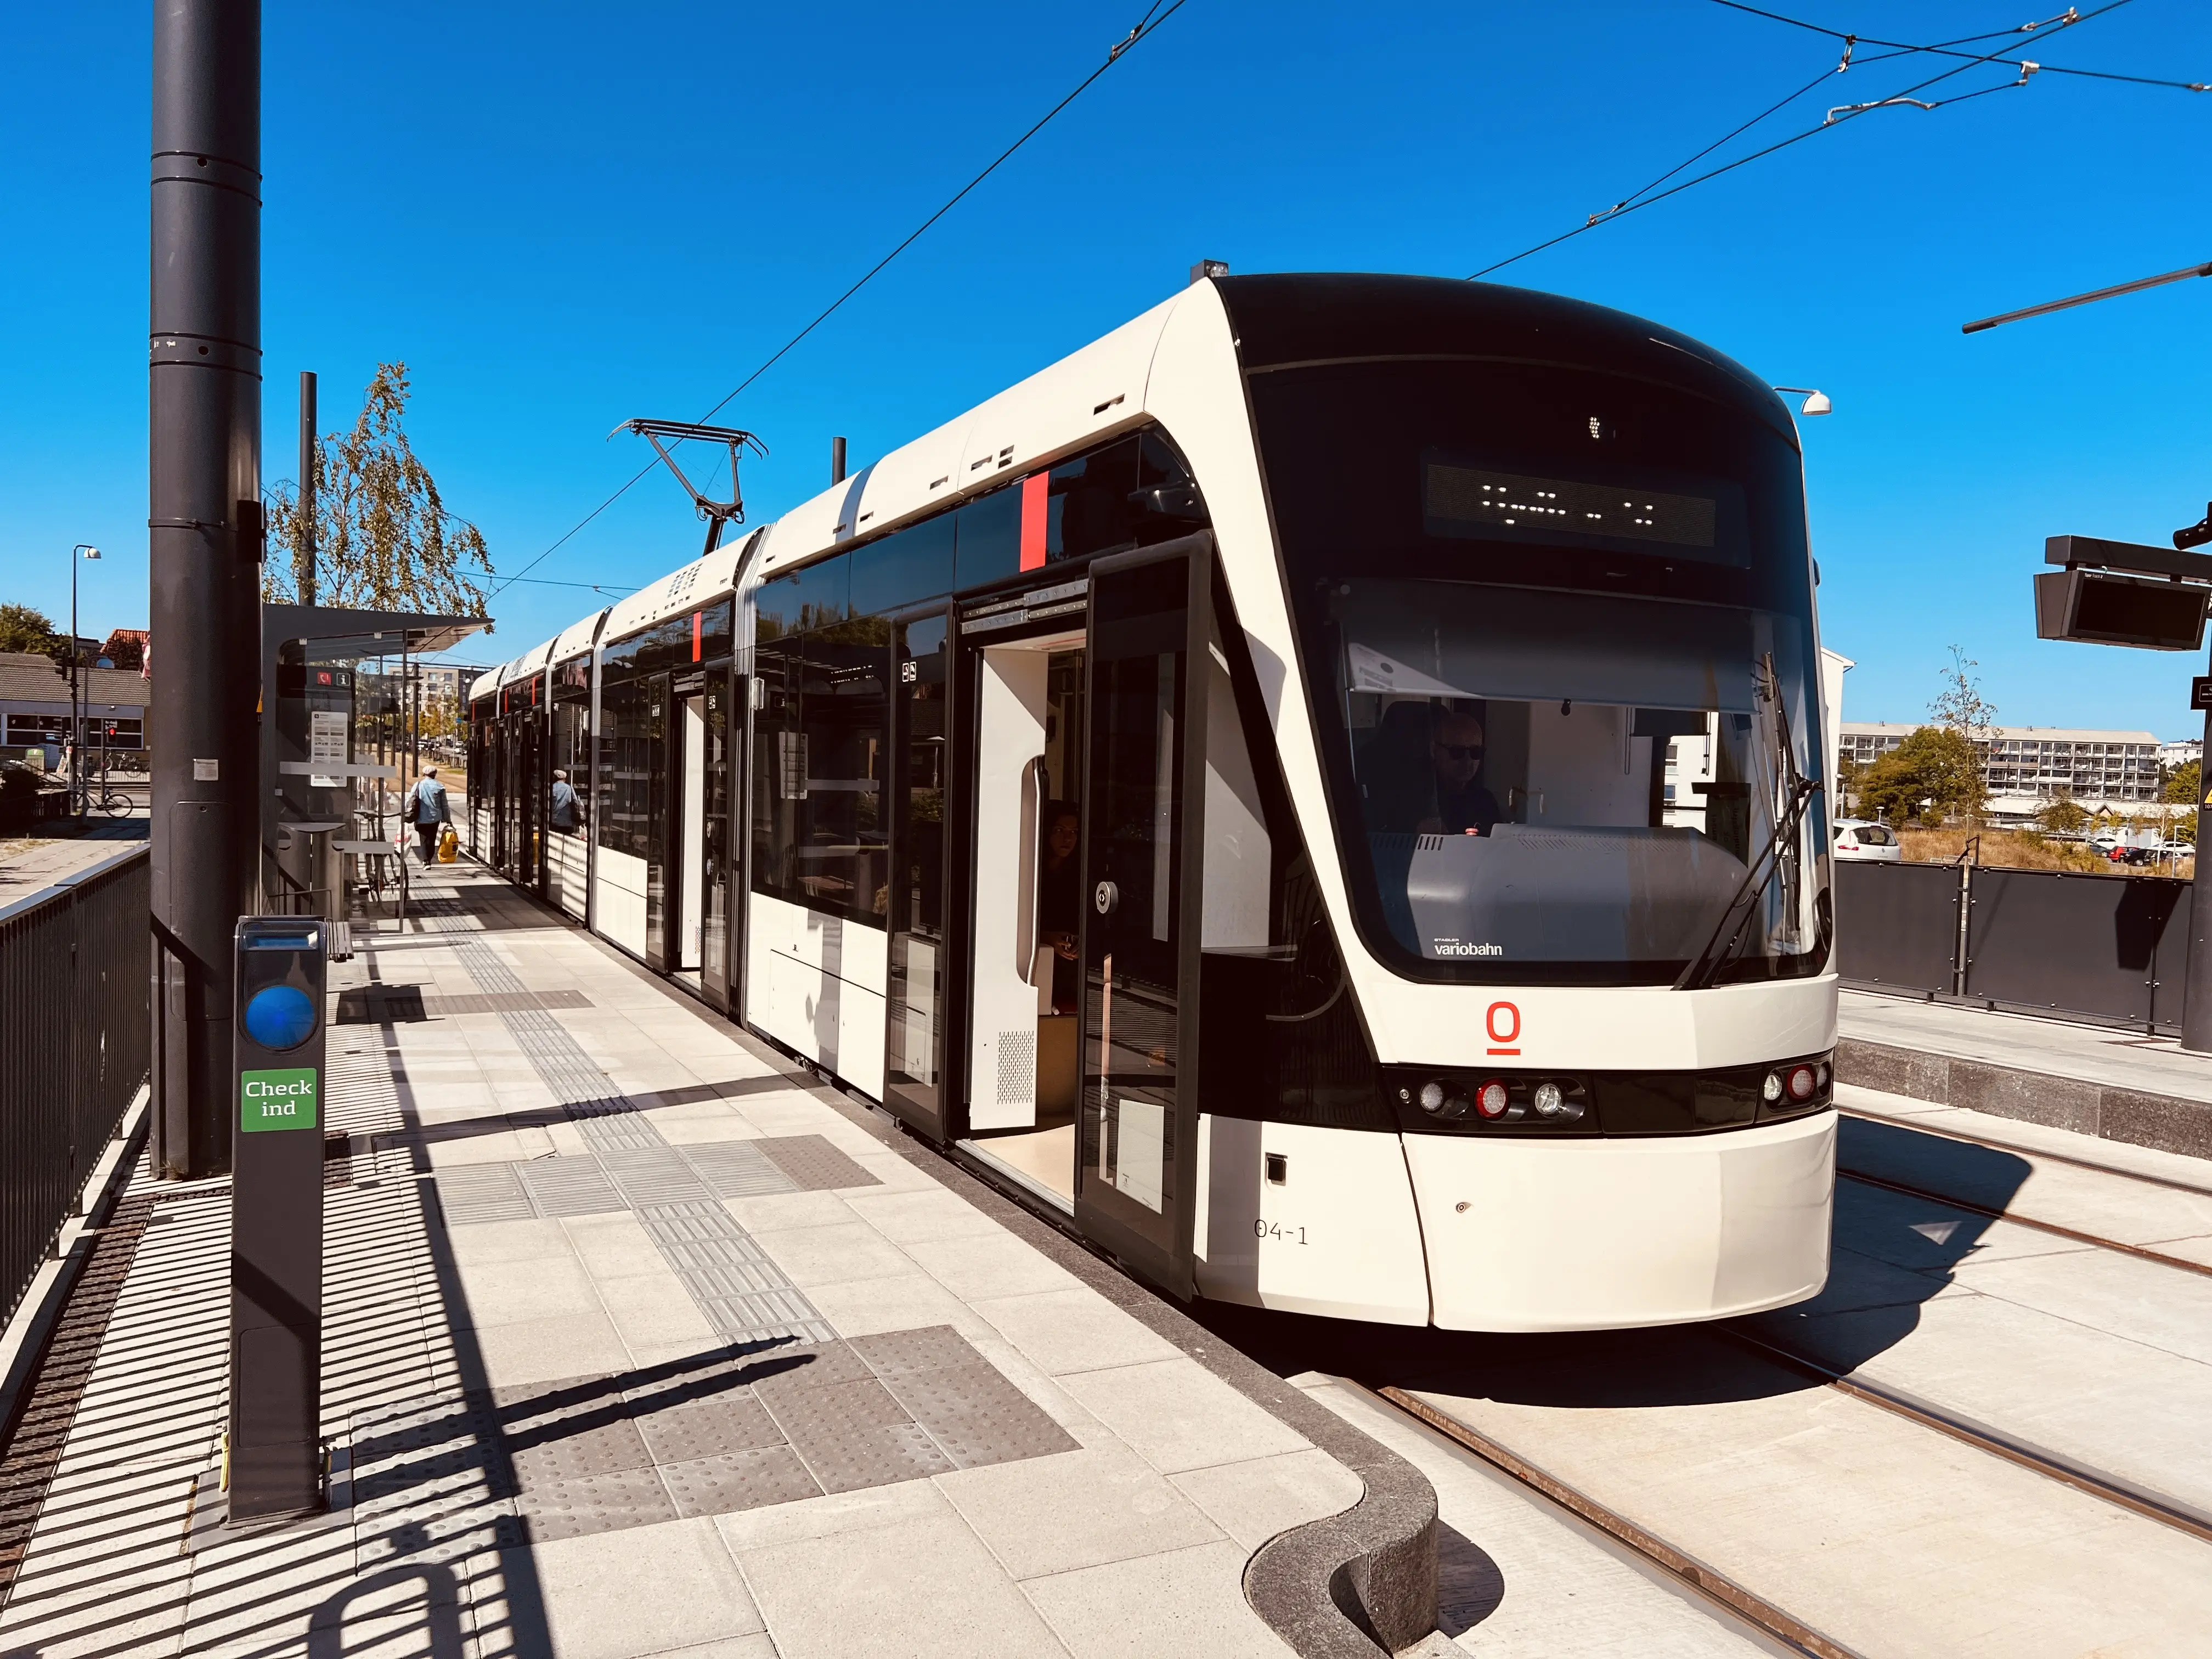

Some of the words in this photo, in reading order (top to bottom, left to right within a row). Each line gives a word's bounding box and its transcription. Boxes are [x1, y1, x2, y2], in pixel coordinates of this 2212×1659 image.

[1434, 943, 1503, 956] variobahn
[246, 1080, 312, 1097] Check
[262, 1100, 296, 1116] ind
[1254, 1219, 1308, 1245] 04-1
